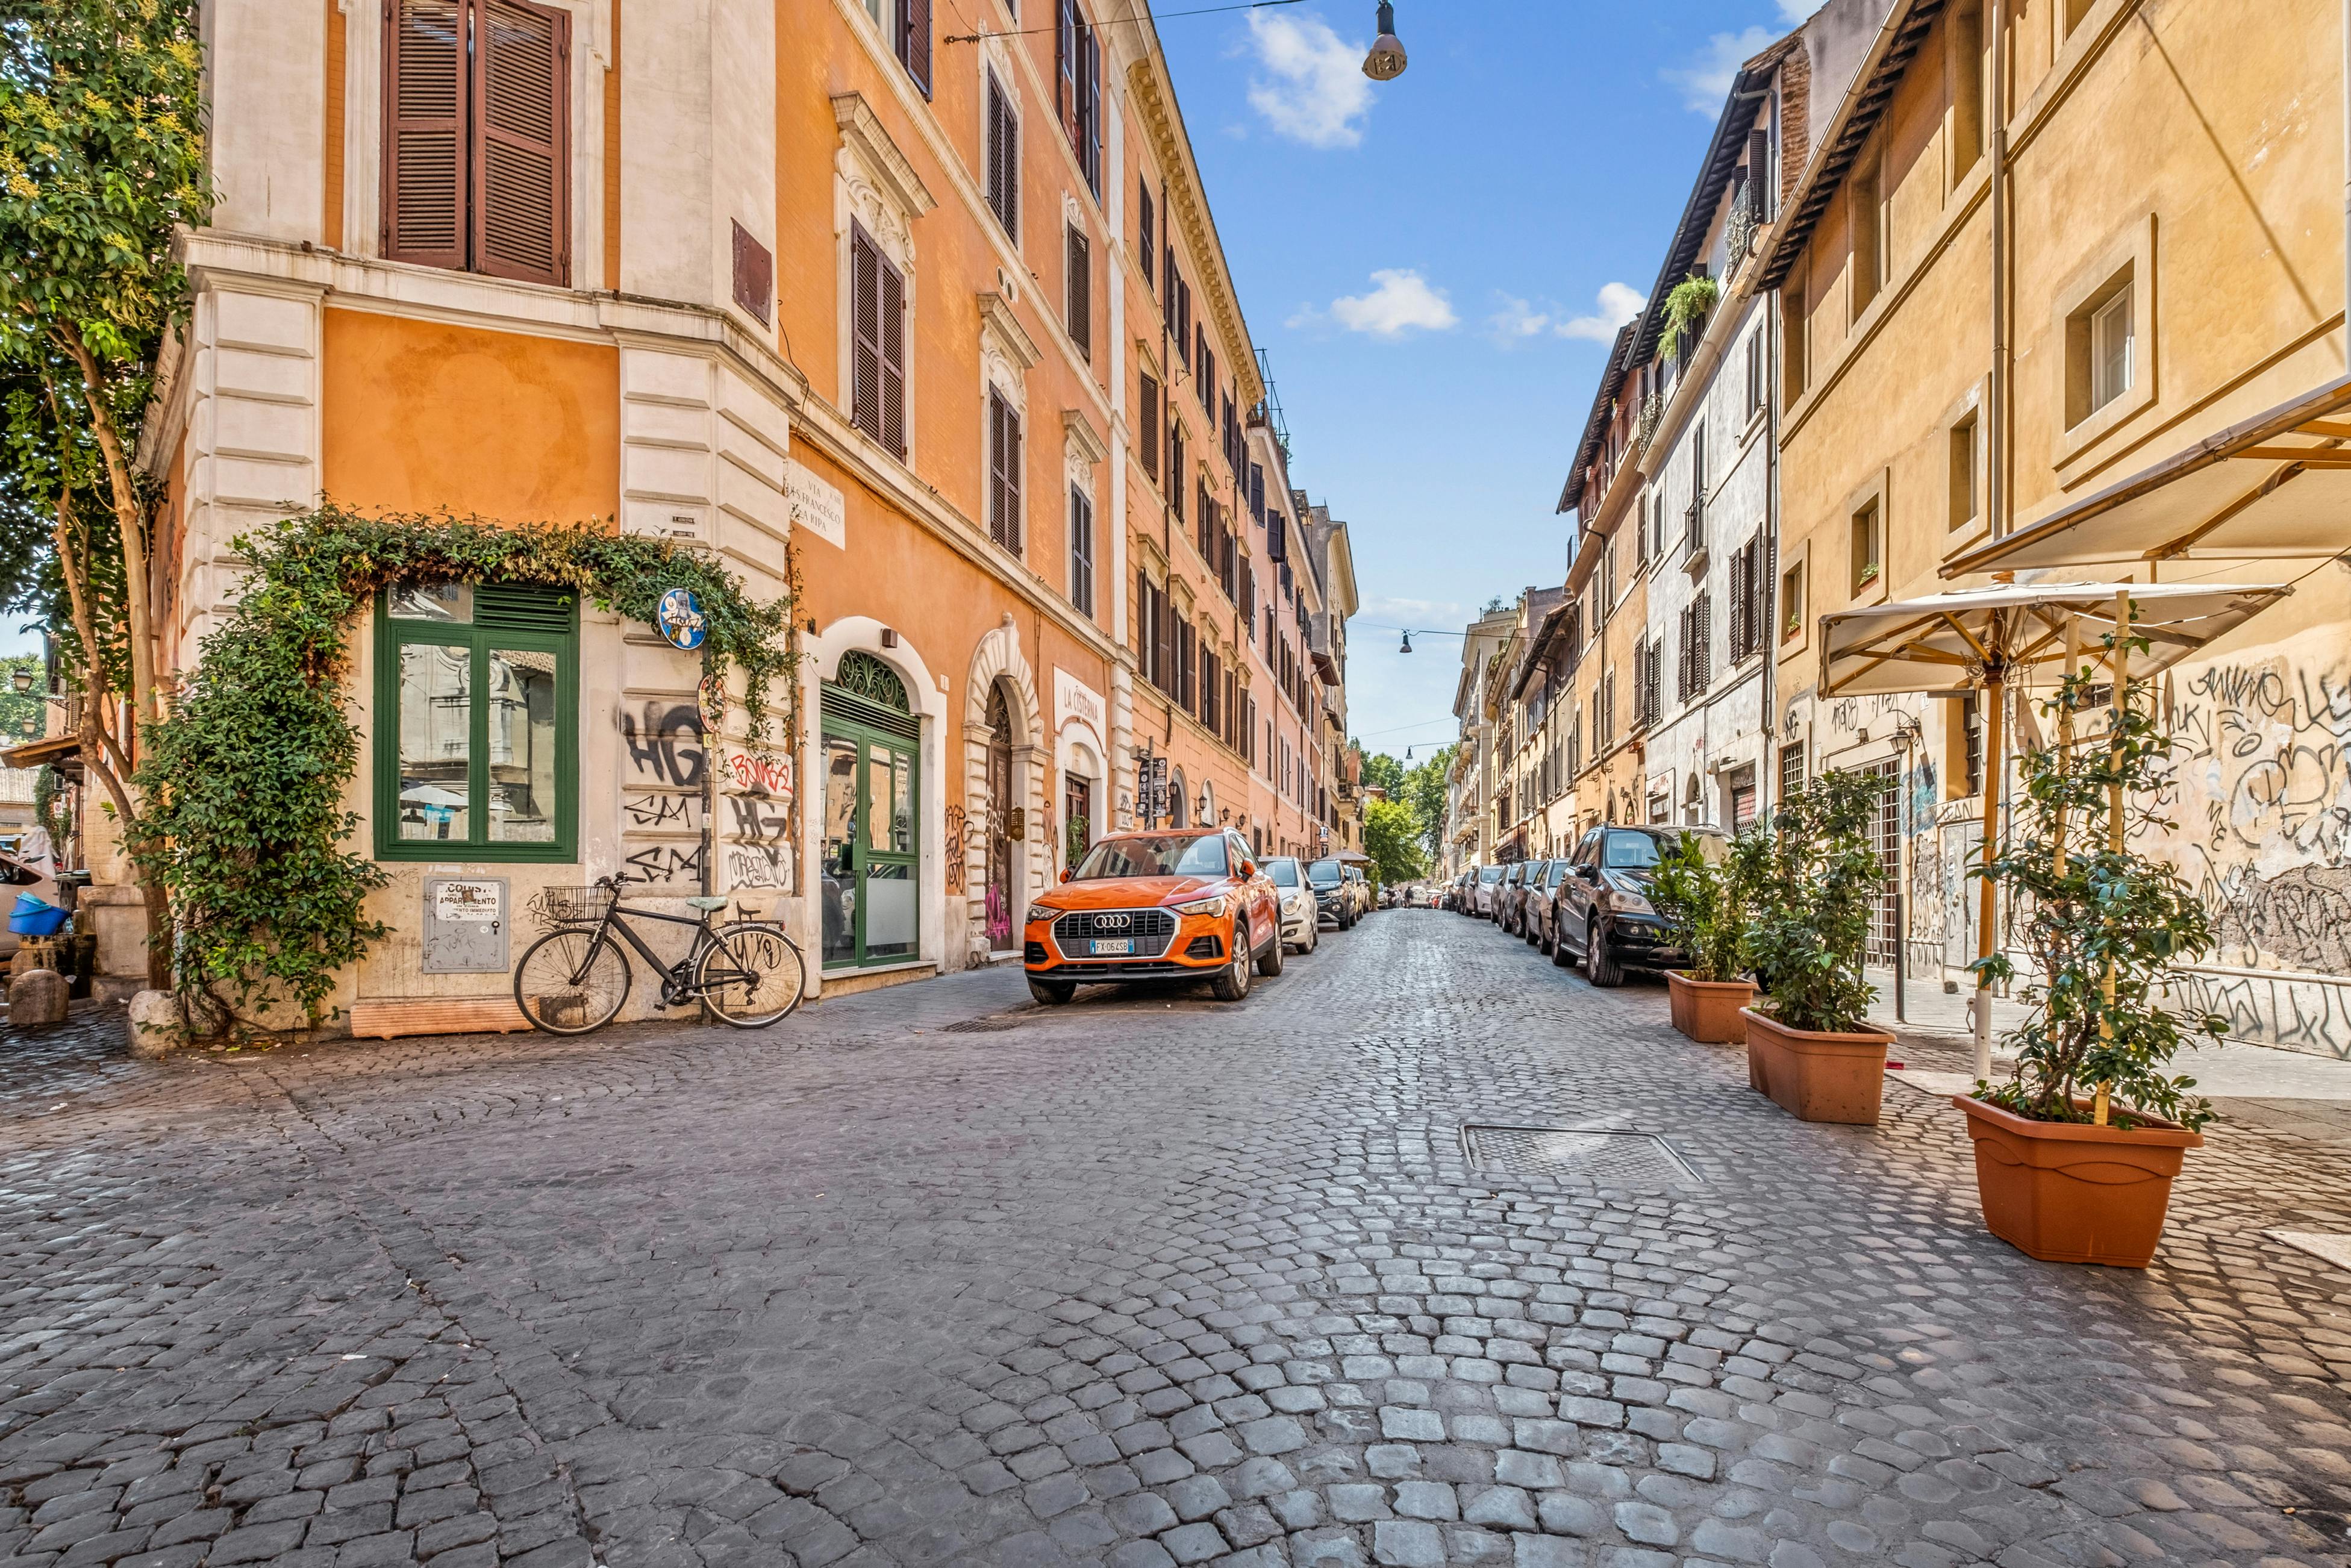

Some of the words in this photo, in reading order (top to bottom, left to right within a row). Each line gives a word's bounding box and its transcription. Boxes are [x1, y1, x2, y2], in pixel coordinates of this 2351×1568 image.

[808, 481, 821, 498] VIA
[810, 513, 827, 532] RIPA
[1064, 686, 1072, 710] LA
[1073, 692, 1099, 723] CISTERNA
